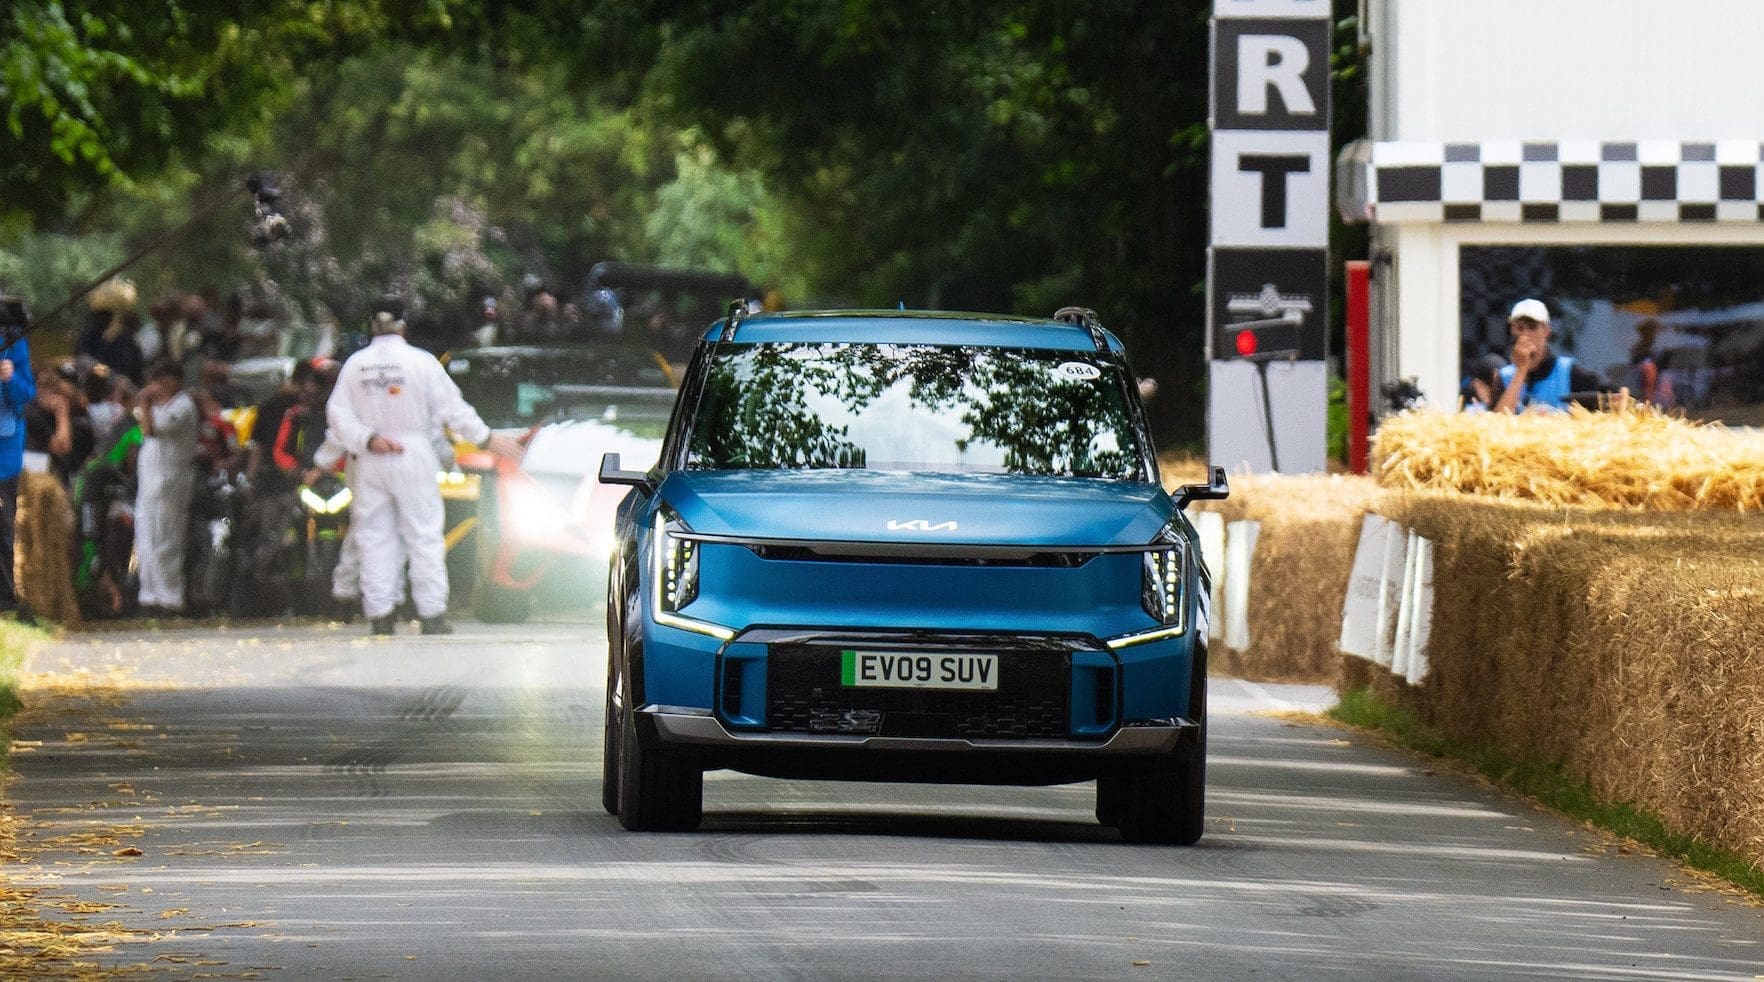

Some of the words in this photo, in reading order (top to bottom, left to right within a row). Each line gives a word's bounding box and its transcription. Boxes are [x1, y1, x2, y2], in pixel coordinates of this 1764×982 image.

[1236, 0, 1318, 228] RT
[1066, 366, 1094, 376] 684
[861, 655, 931, 681] EV09
[940, 657, 991, 683] SUV
